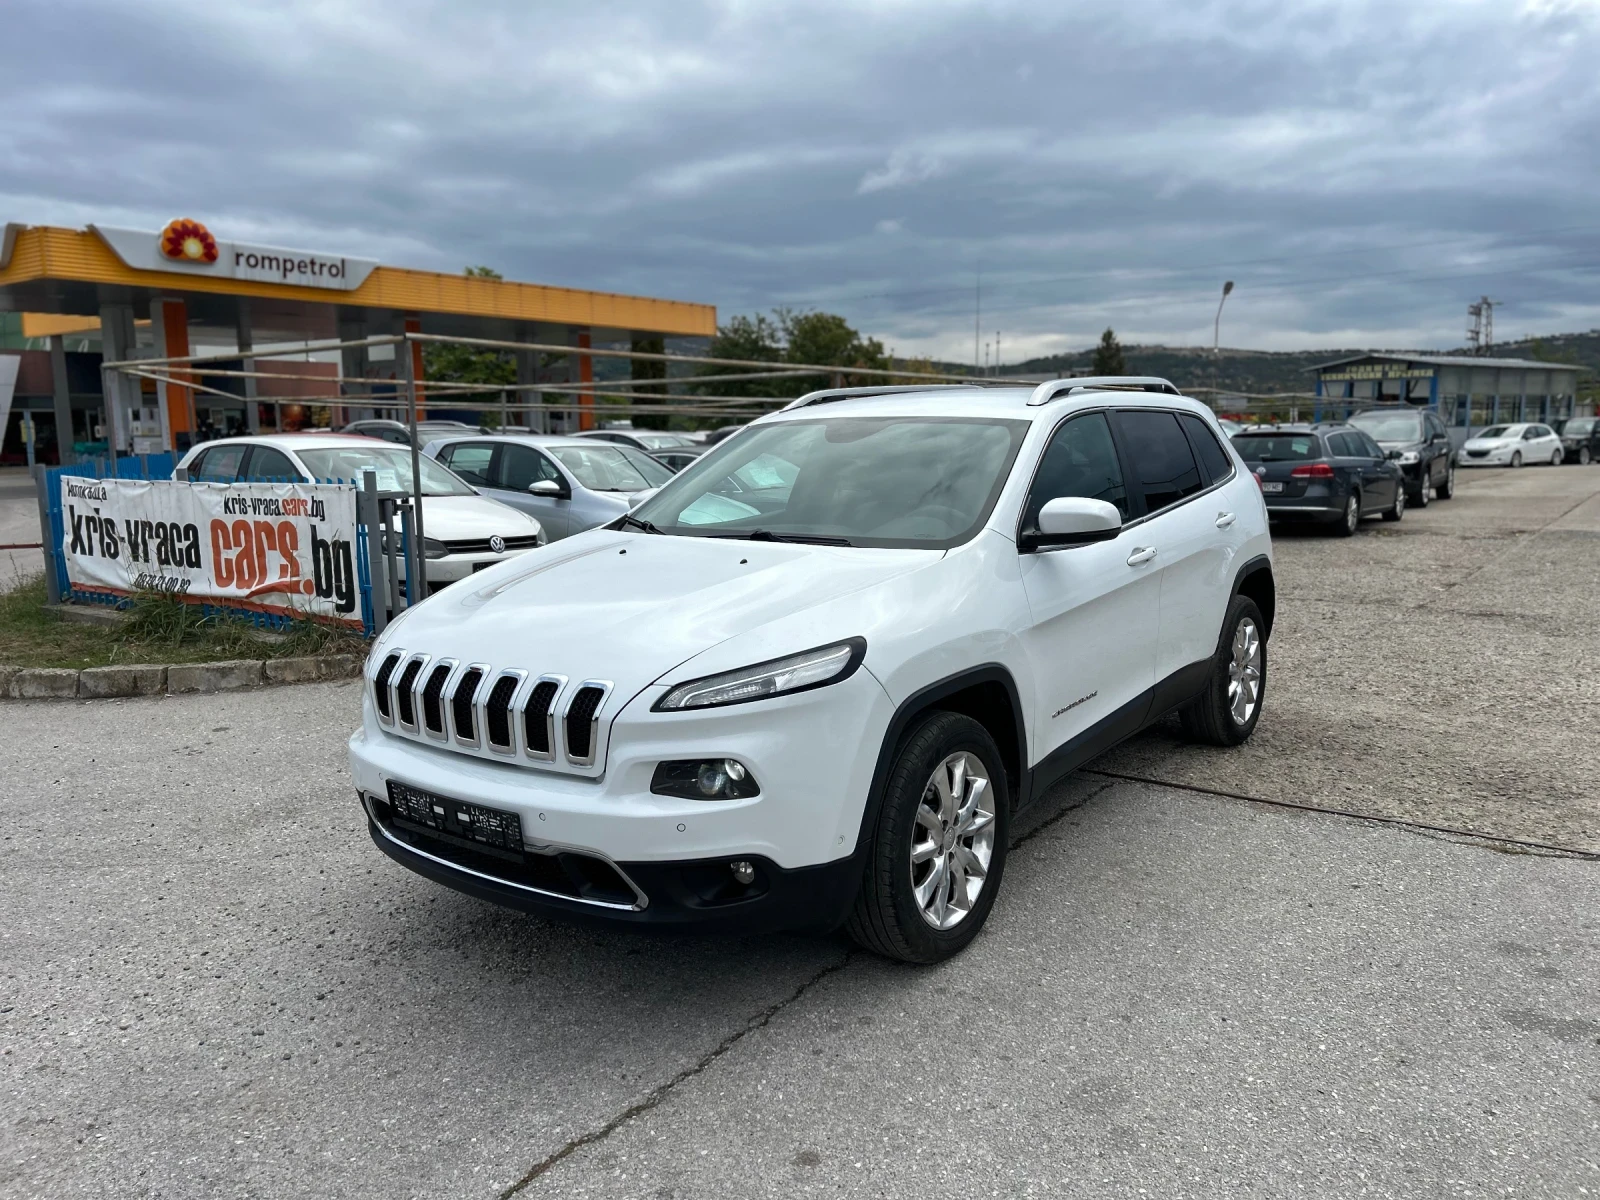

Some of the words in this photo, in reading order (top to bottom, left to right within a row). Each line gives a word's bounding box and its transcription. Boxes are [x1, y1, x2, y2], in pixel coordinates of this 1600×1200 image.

[235, 252, 345, 279] rompetrol
[224, 494, 325, 521] kris-vraca.cars.bg
[69, 505, 202, 569] kris-vraca
